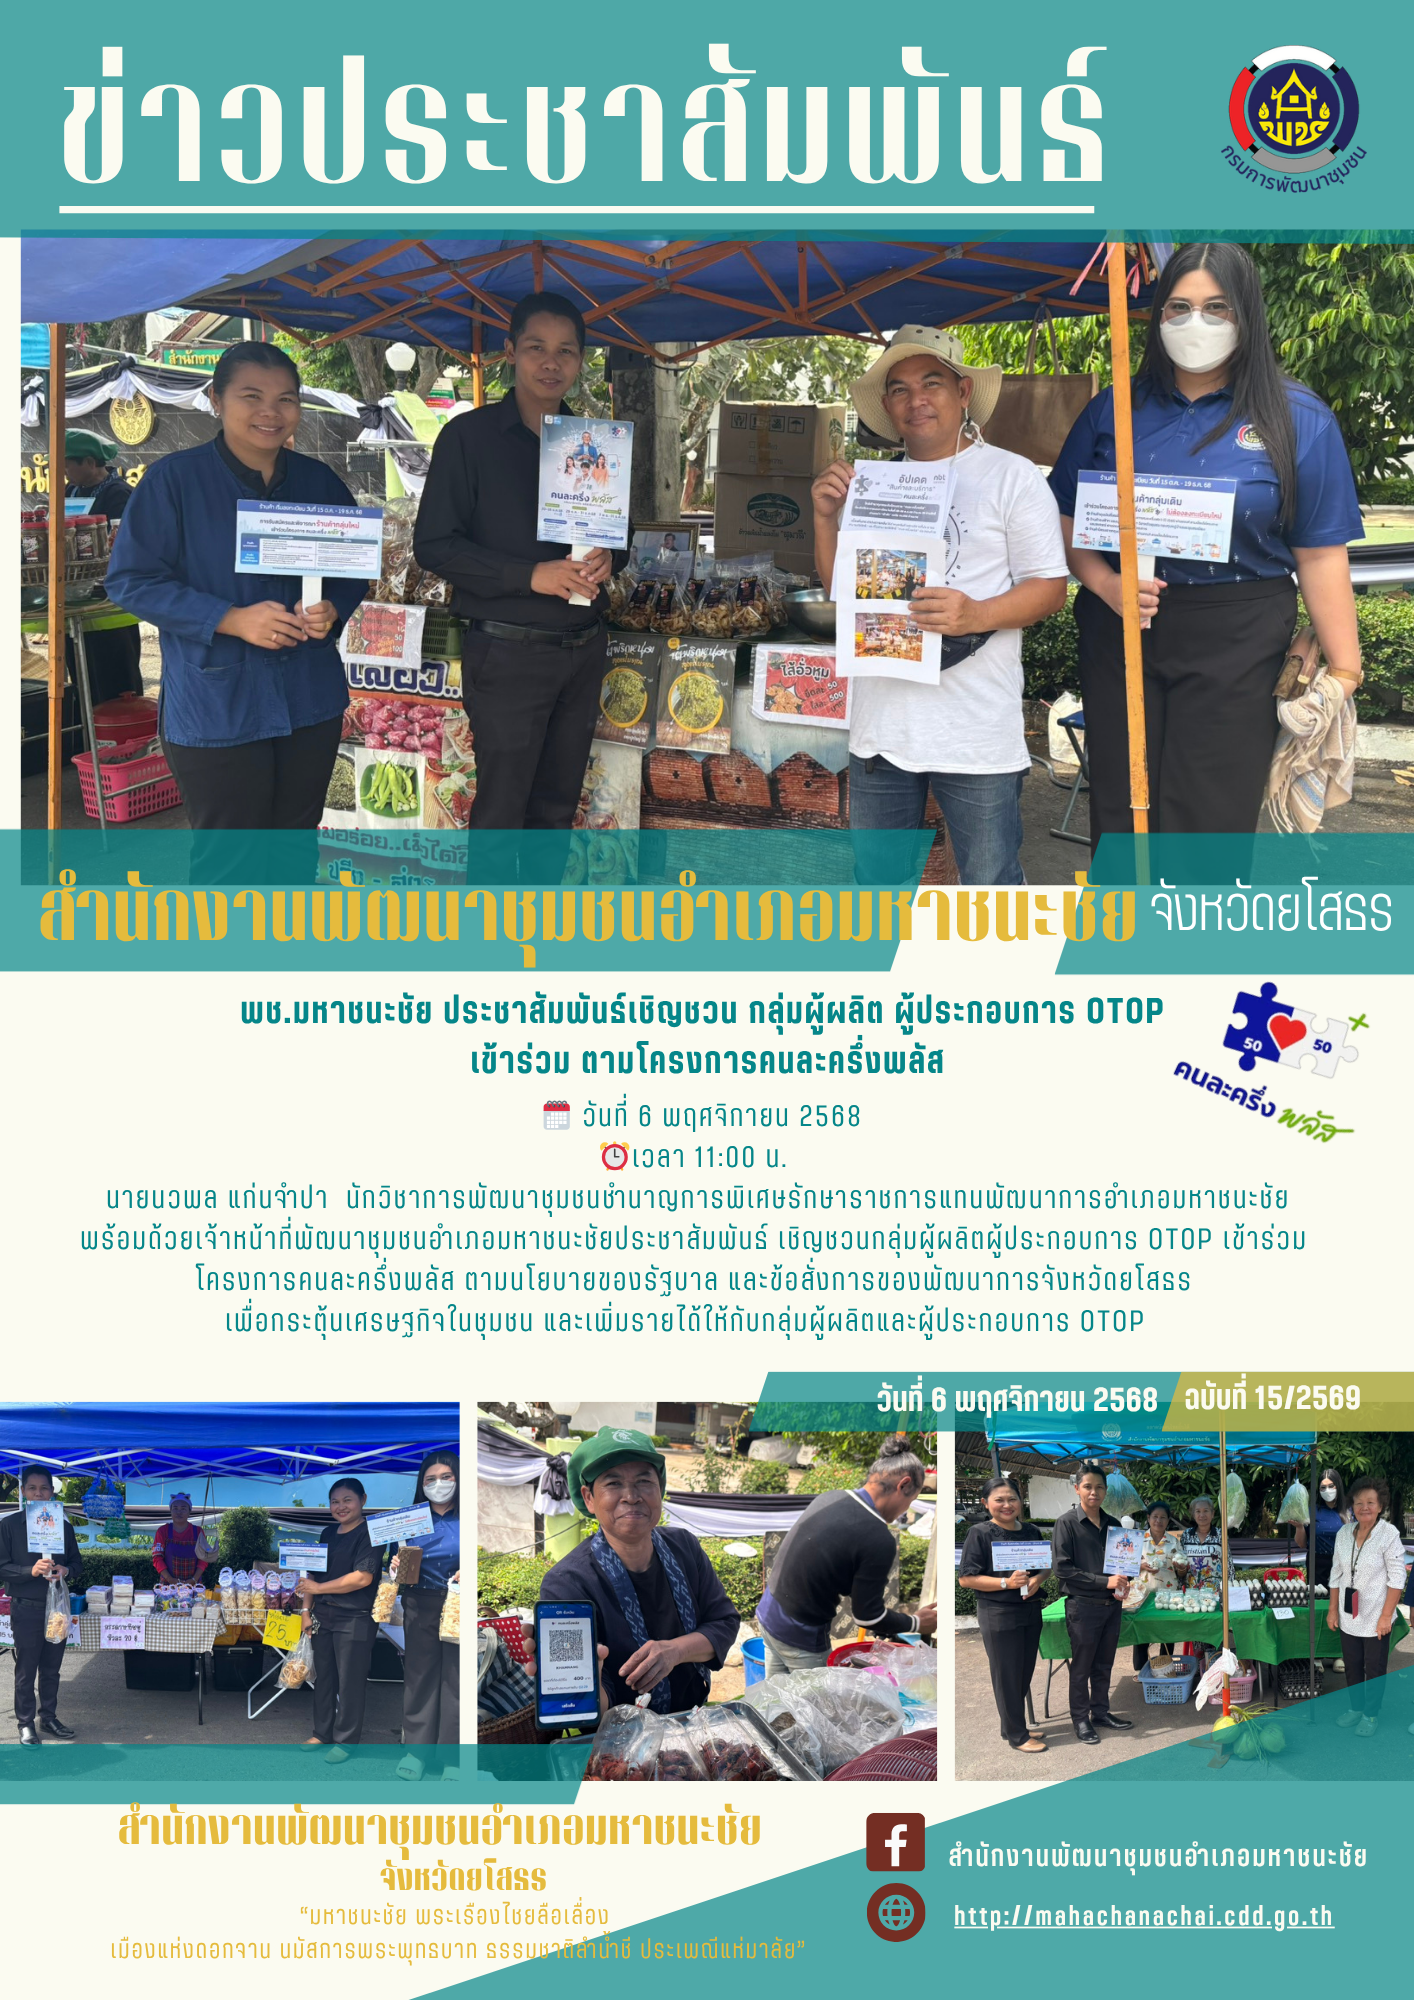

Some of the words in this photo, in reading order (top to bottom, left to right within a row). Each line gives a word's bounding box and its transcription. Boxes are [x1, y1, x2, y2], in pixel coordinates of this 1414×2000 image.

[1135, 493, 1183, 507] นค้ากลุ่มเดิม
[827, 681, 838, 690] 50
[829, 690, 844, 702] 500
[266, 1620, 287, 1640] 25
[124, 1634, 132, 1642] 20
